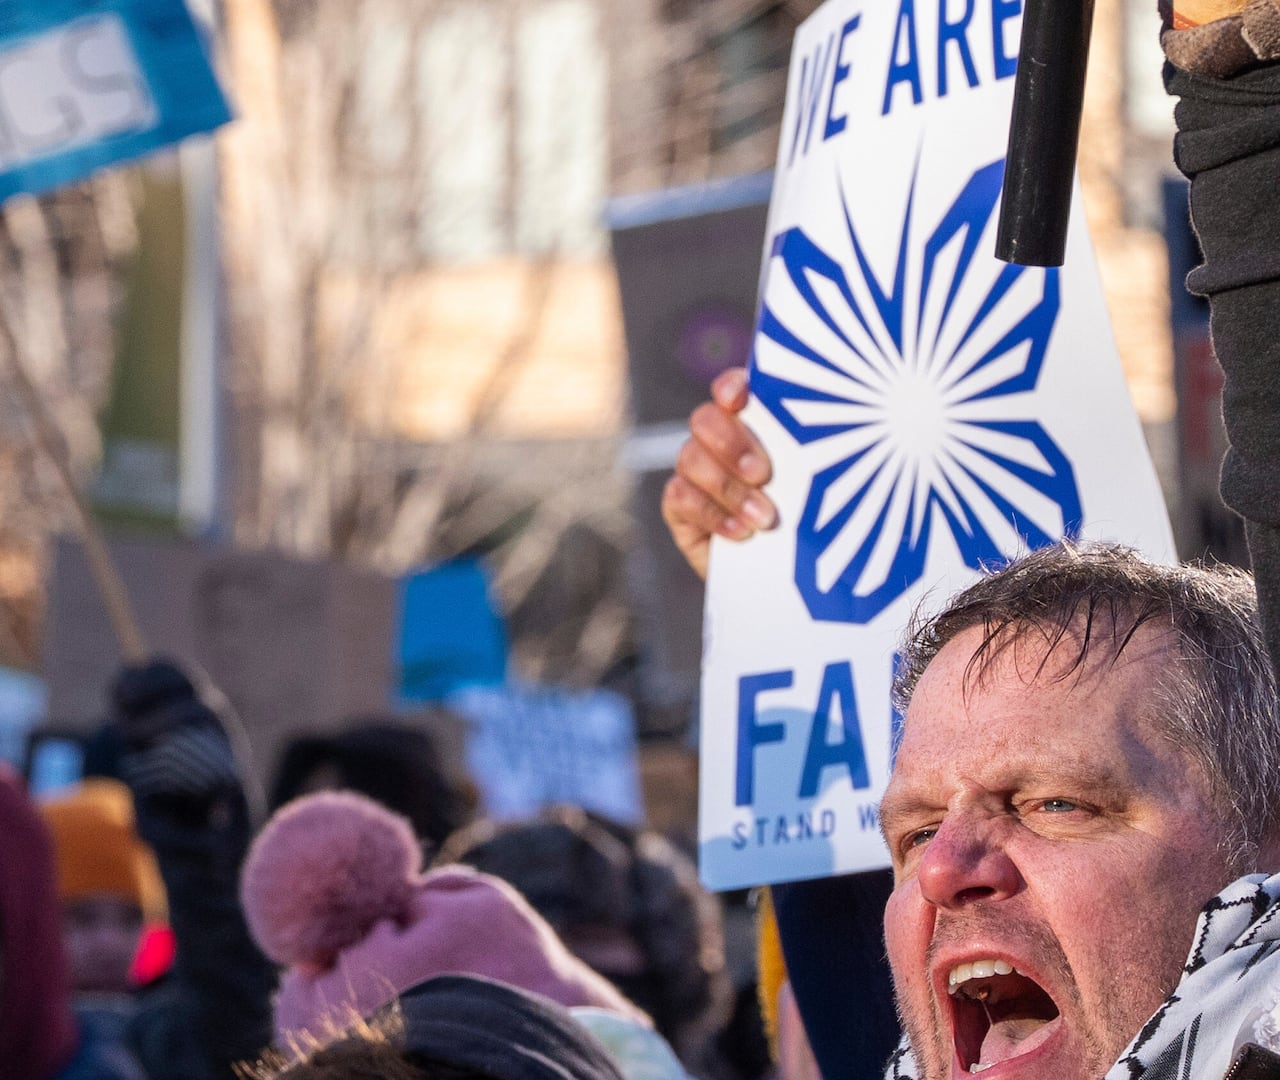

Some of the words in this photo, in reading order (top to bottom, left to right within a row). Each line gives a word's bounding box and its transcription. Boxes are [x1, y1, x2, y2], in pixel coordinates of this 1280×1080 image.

[787, 12, 861, 170] WE
[881, 0, 1022, 116] ARE
[732, 810, 836, 851] STAND
